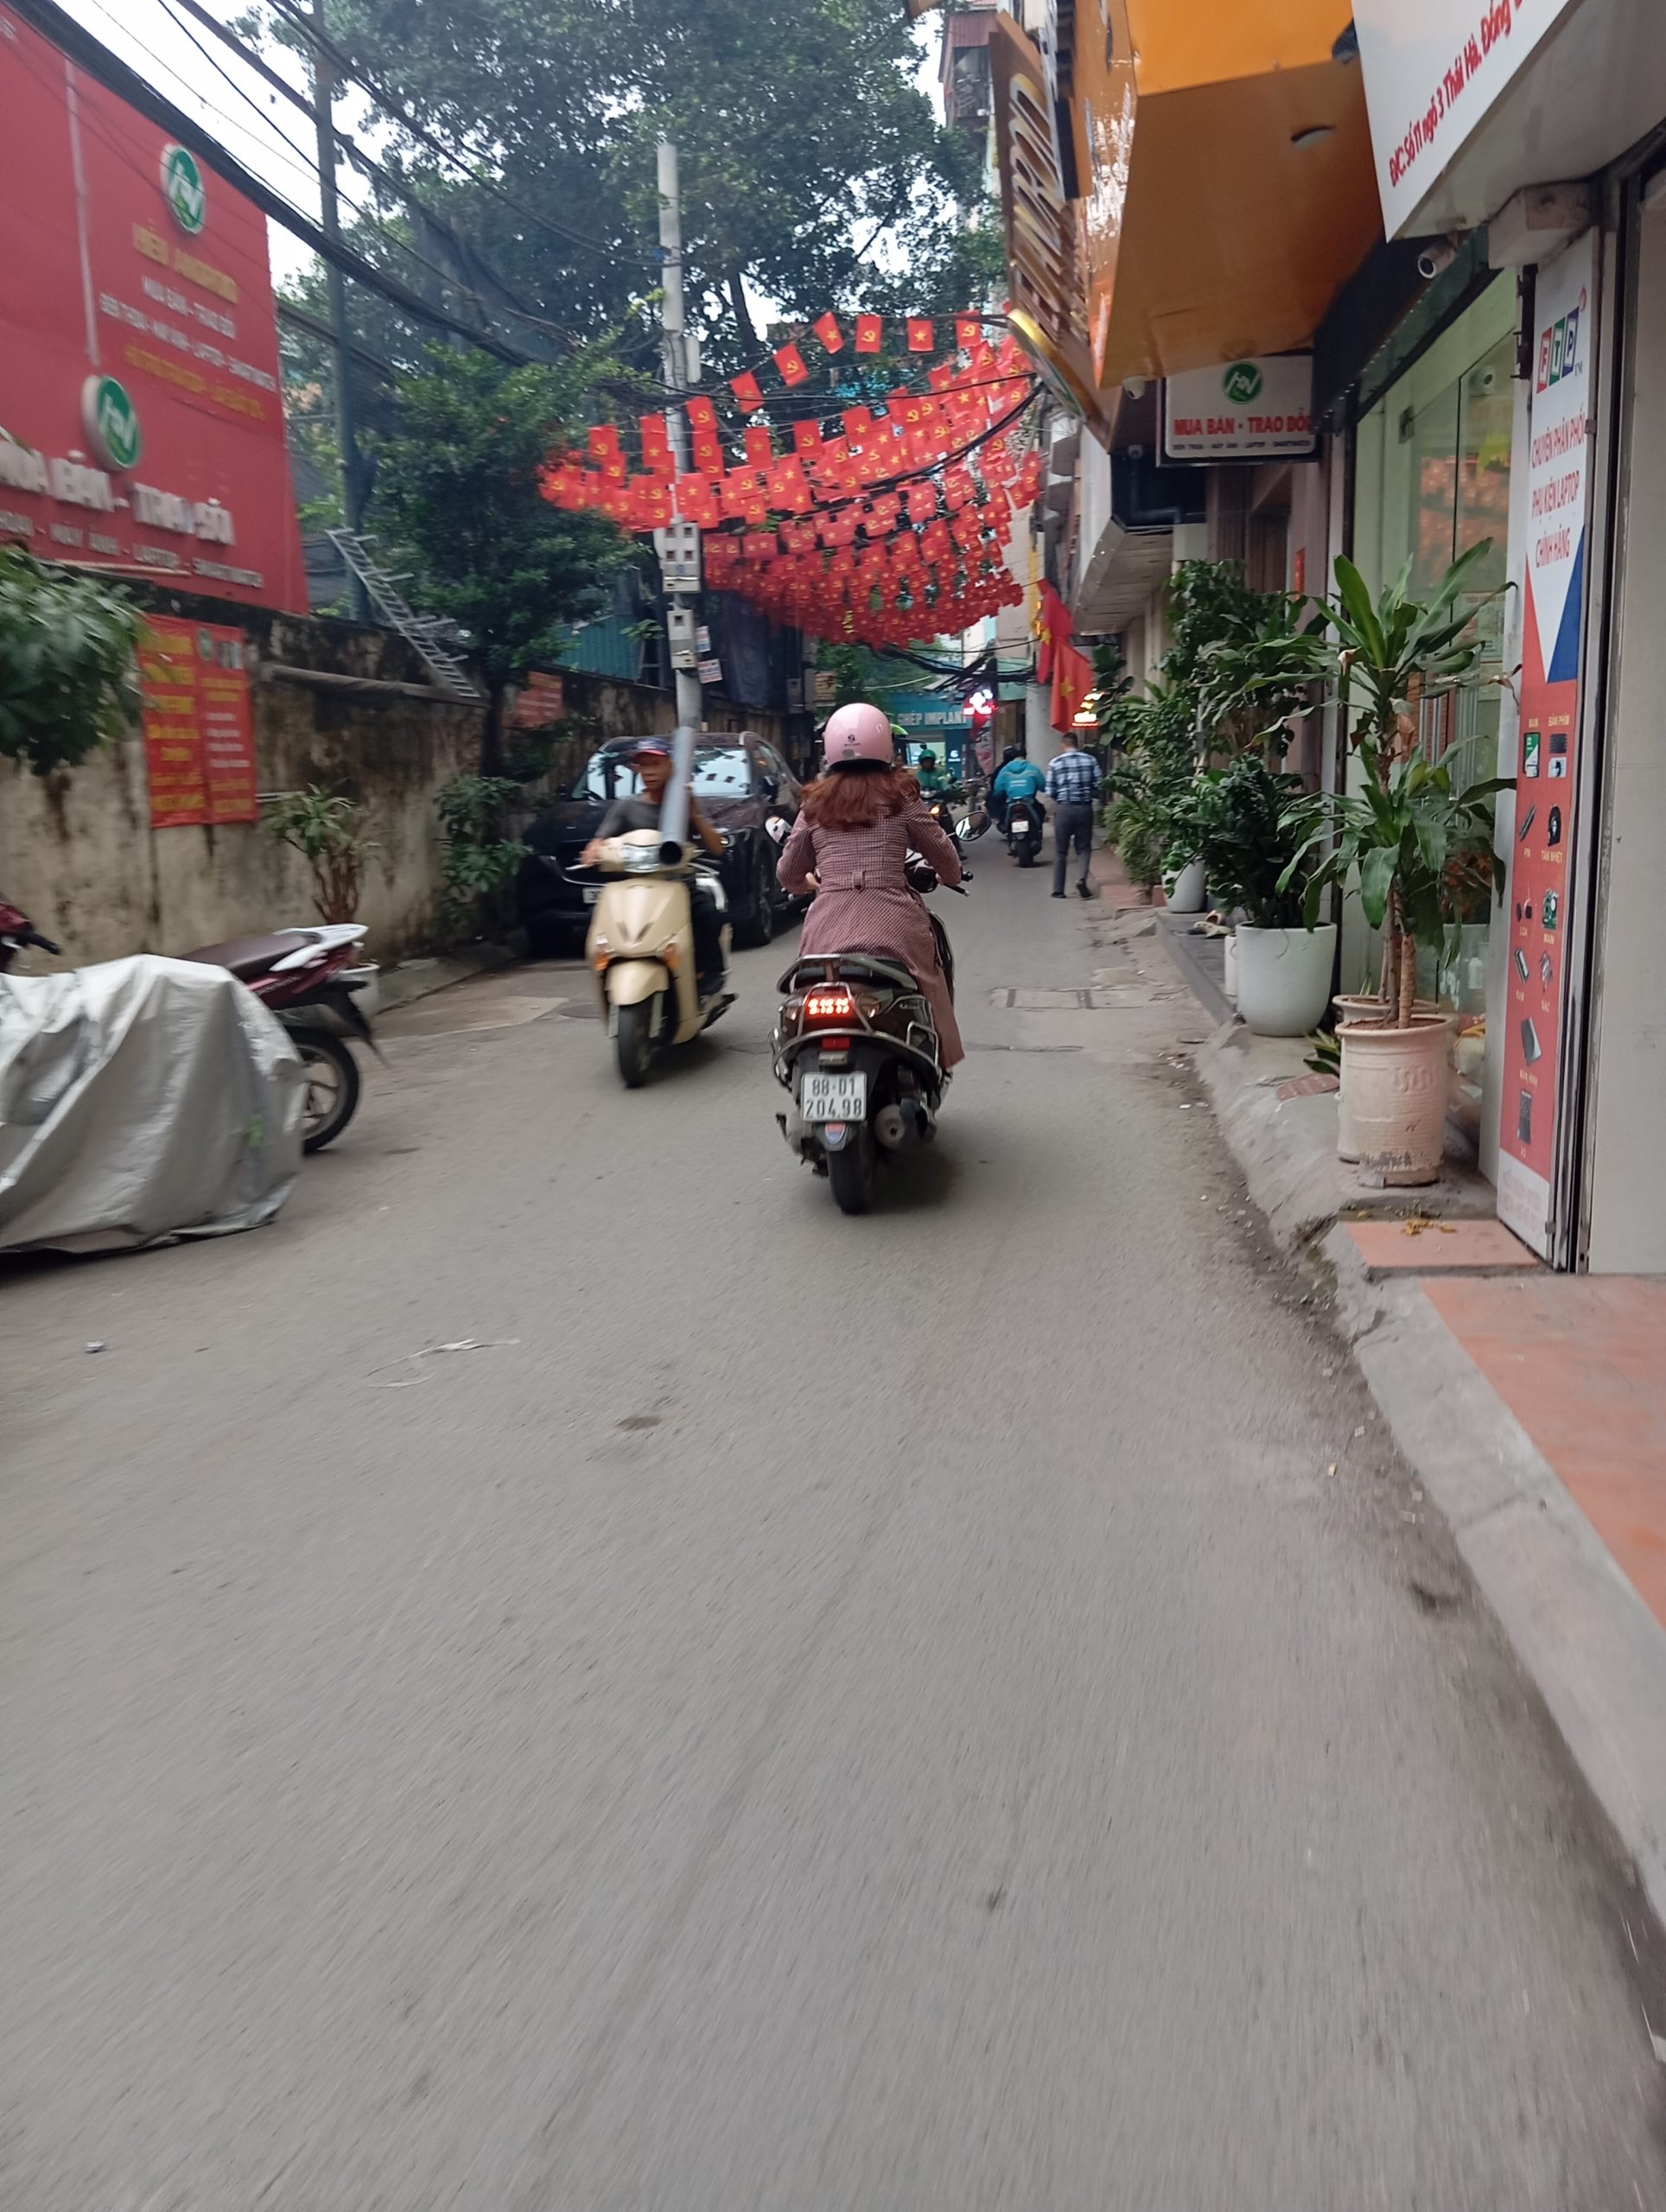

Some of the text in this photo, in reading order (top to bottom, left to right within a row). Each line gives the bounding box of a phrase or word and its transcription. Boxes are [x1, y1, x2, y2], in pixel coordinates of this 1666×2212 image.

[1437, 86, 1444, 119] 3
[1539, 316, 1577, 382] FTP
[1173, 419, 1203, 435] MUA
[1206, 415, 1235, 435] BÁN
[1247, 416, 1284, 434] TRAO
[1557, 470, 1580, 508] LAPTOP
[811, 1077, 855, 1096] 88-D1
[805, 1098, 862, 1119] 204.98
